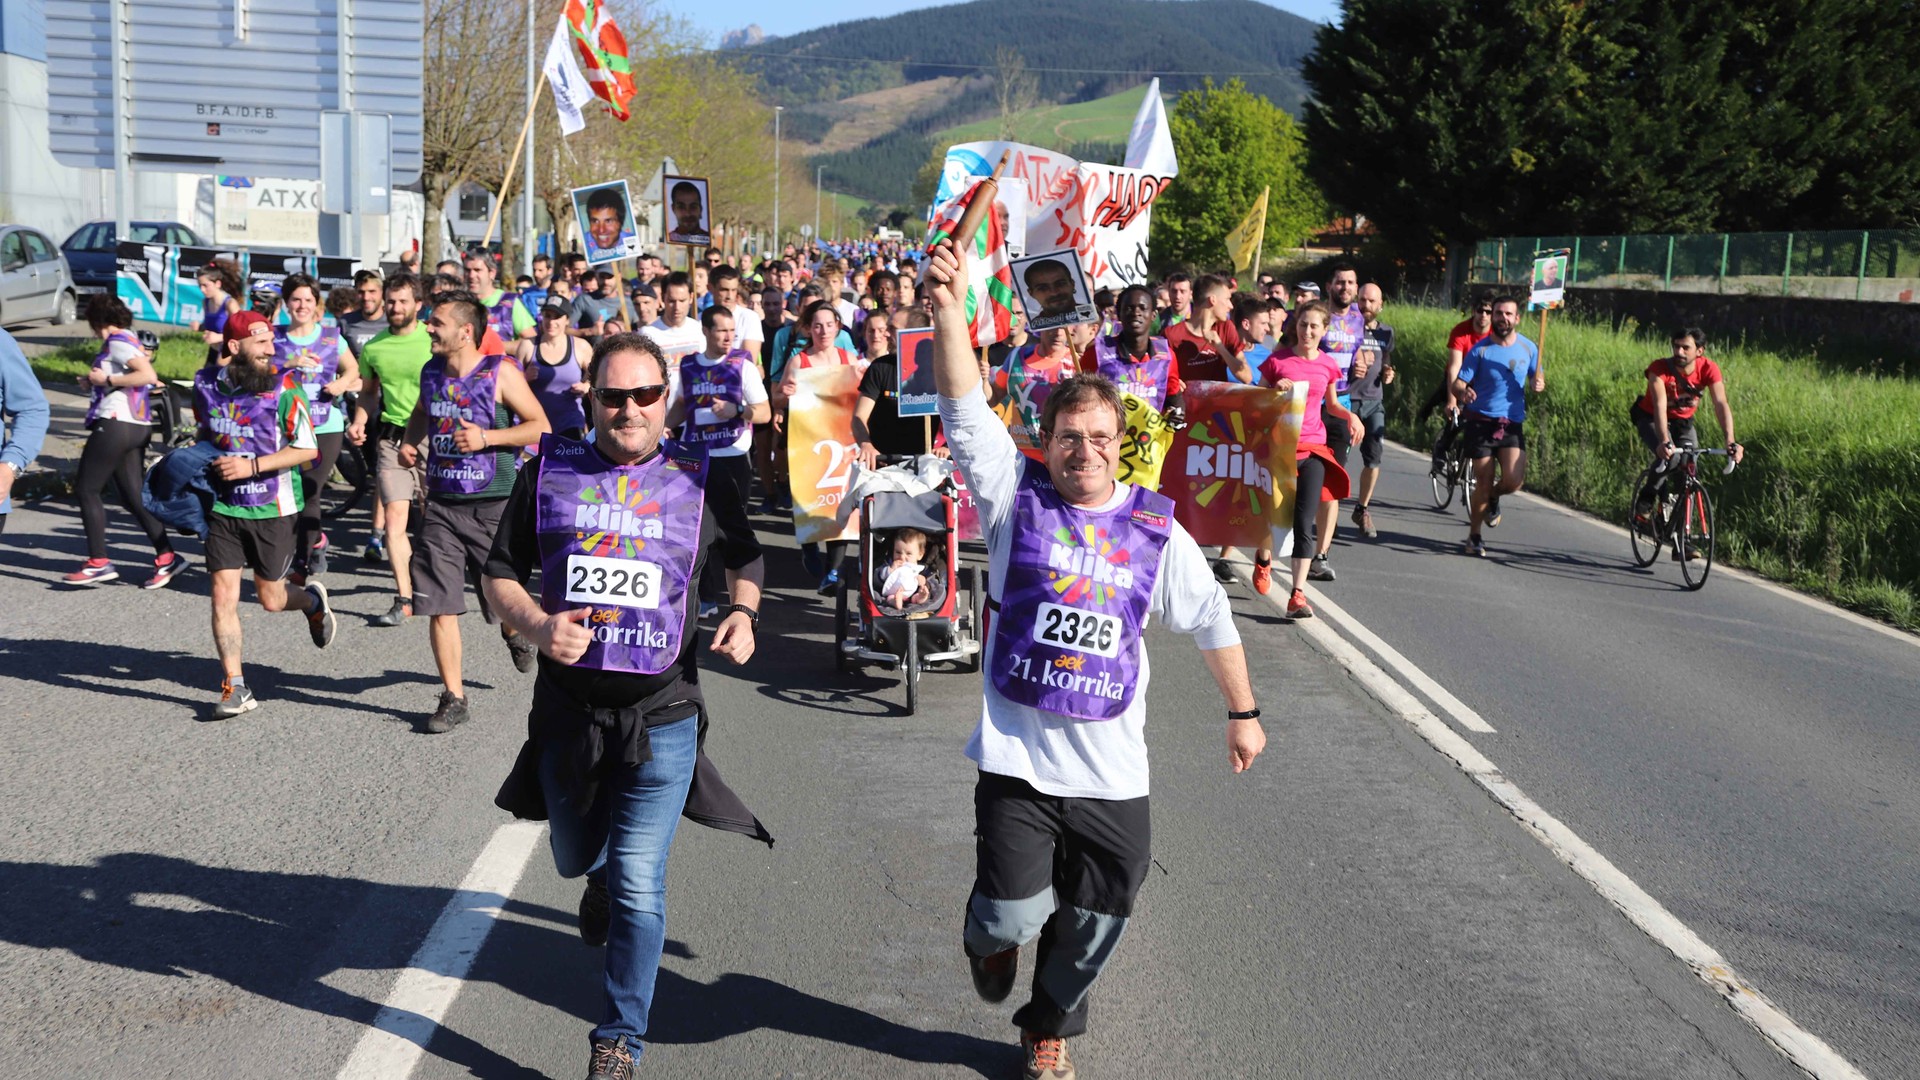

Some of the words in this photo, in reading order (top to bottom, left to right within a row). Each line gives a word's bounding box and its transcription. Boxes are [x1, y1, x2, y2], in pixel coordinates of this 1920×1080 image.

[196, 104, 278, 119] B.F.A./D.F.B.
[692, 381, 727, 395] Klika
[1118, 382, 1158, 398] Klika
[431, 401, 473, 420] Klika
[210, 417, 255, 439] Klika
[702, 428, 739, 441] korrika
[565, 446, 586, 456] eitb
[437, 465, 485, 480] korrika
[1185, 443, 1273, 496] Klika
[233, 480, 269, 495] rrika
[817, 492, 843, 507] 201
[574, 503, 664, 539] Klika
[1048, 543, 1134, 590] Klika
[570, 565, 650, 599] 2326
[592, 605, 623, 625] aek
[584, 614, 668, 649] korrika
[1042, 608, 1114, 651] 2326
[1054, 651, 1087, 673] aek
[1008, 653, 1037, 682] 21.
[1041, 662, 1125, 701] korrika
